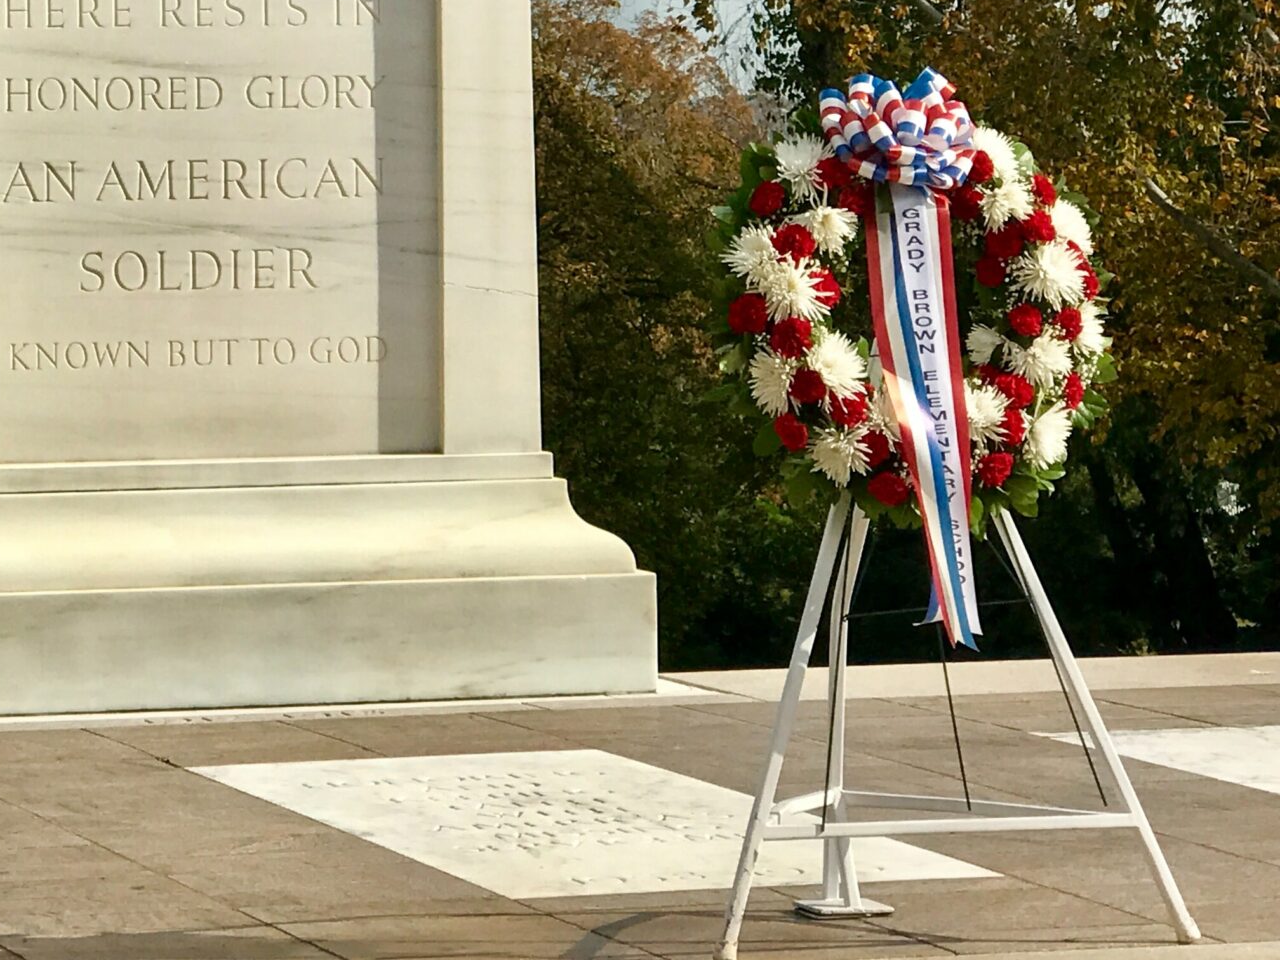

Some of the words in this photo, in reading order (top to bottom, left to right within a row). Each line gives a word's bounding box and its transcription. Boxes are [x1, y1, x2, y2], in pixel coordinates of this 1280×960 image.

[4, 76, 224, 112] HONORED
[245, 74, 387, 110] GLORY
[2, 160, 78, 203] AN
[95, 157, 385, 201] AMERICAN
[902, 208, 926, 273] GRADY
[79, 247, 320, 292] SOLDIER
[913, 289, 936, 354] BROWN
[9, 341, 150, 371] KNOWN
[168, 339, 240, 367] BUT
[250, 338, 297, 366] TO
[309, 335, 389, 365] GOD
